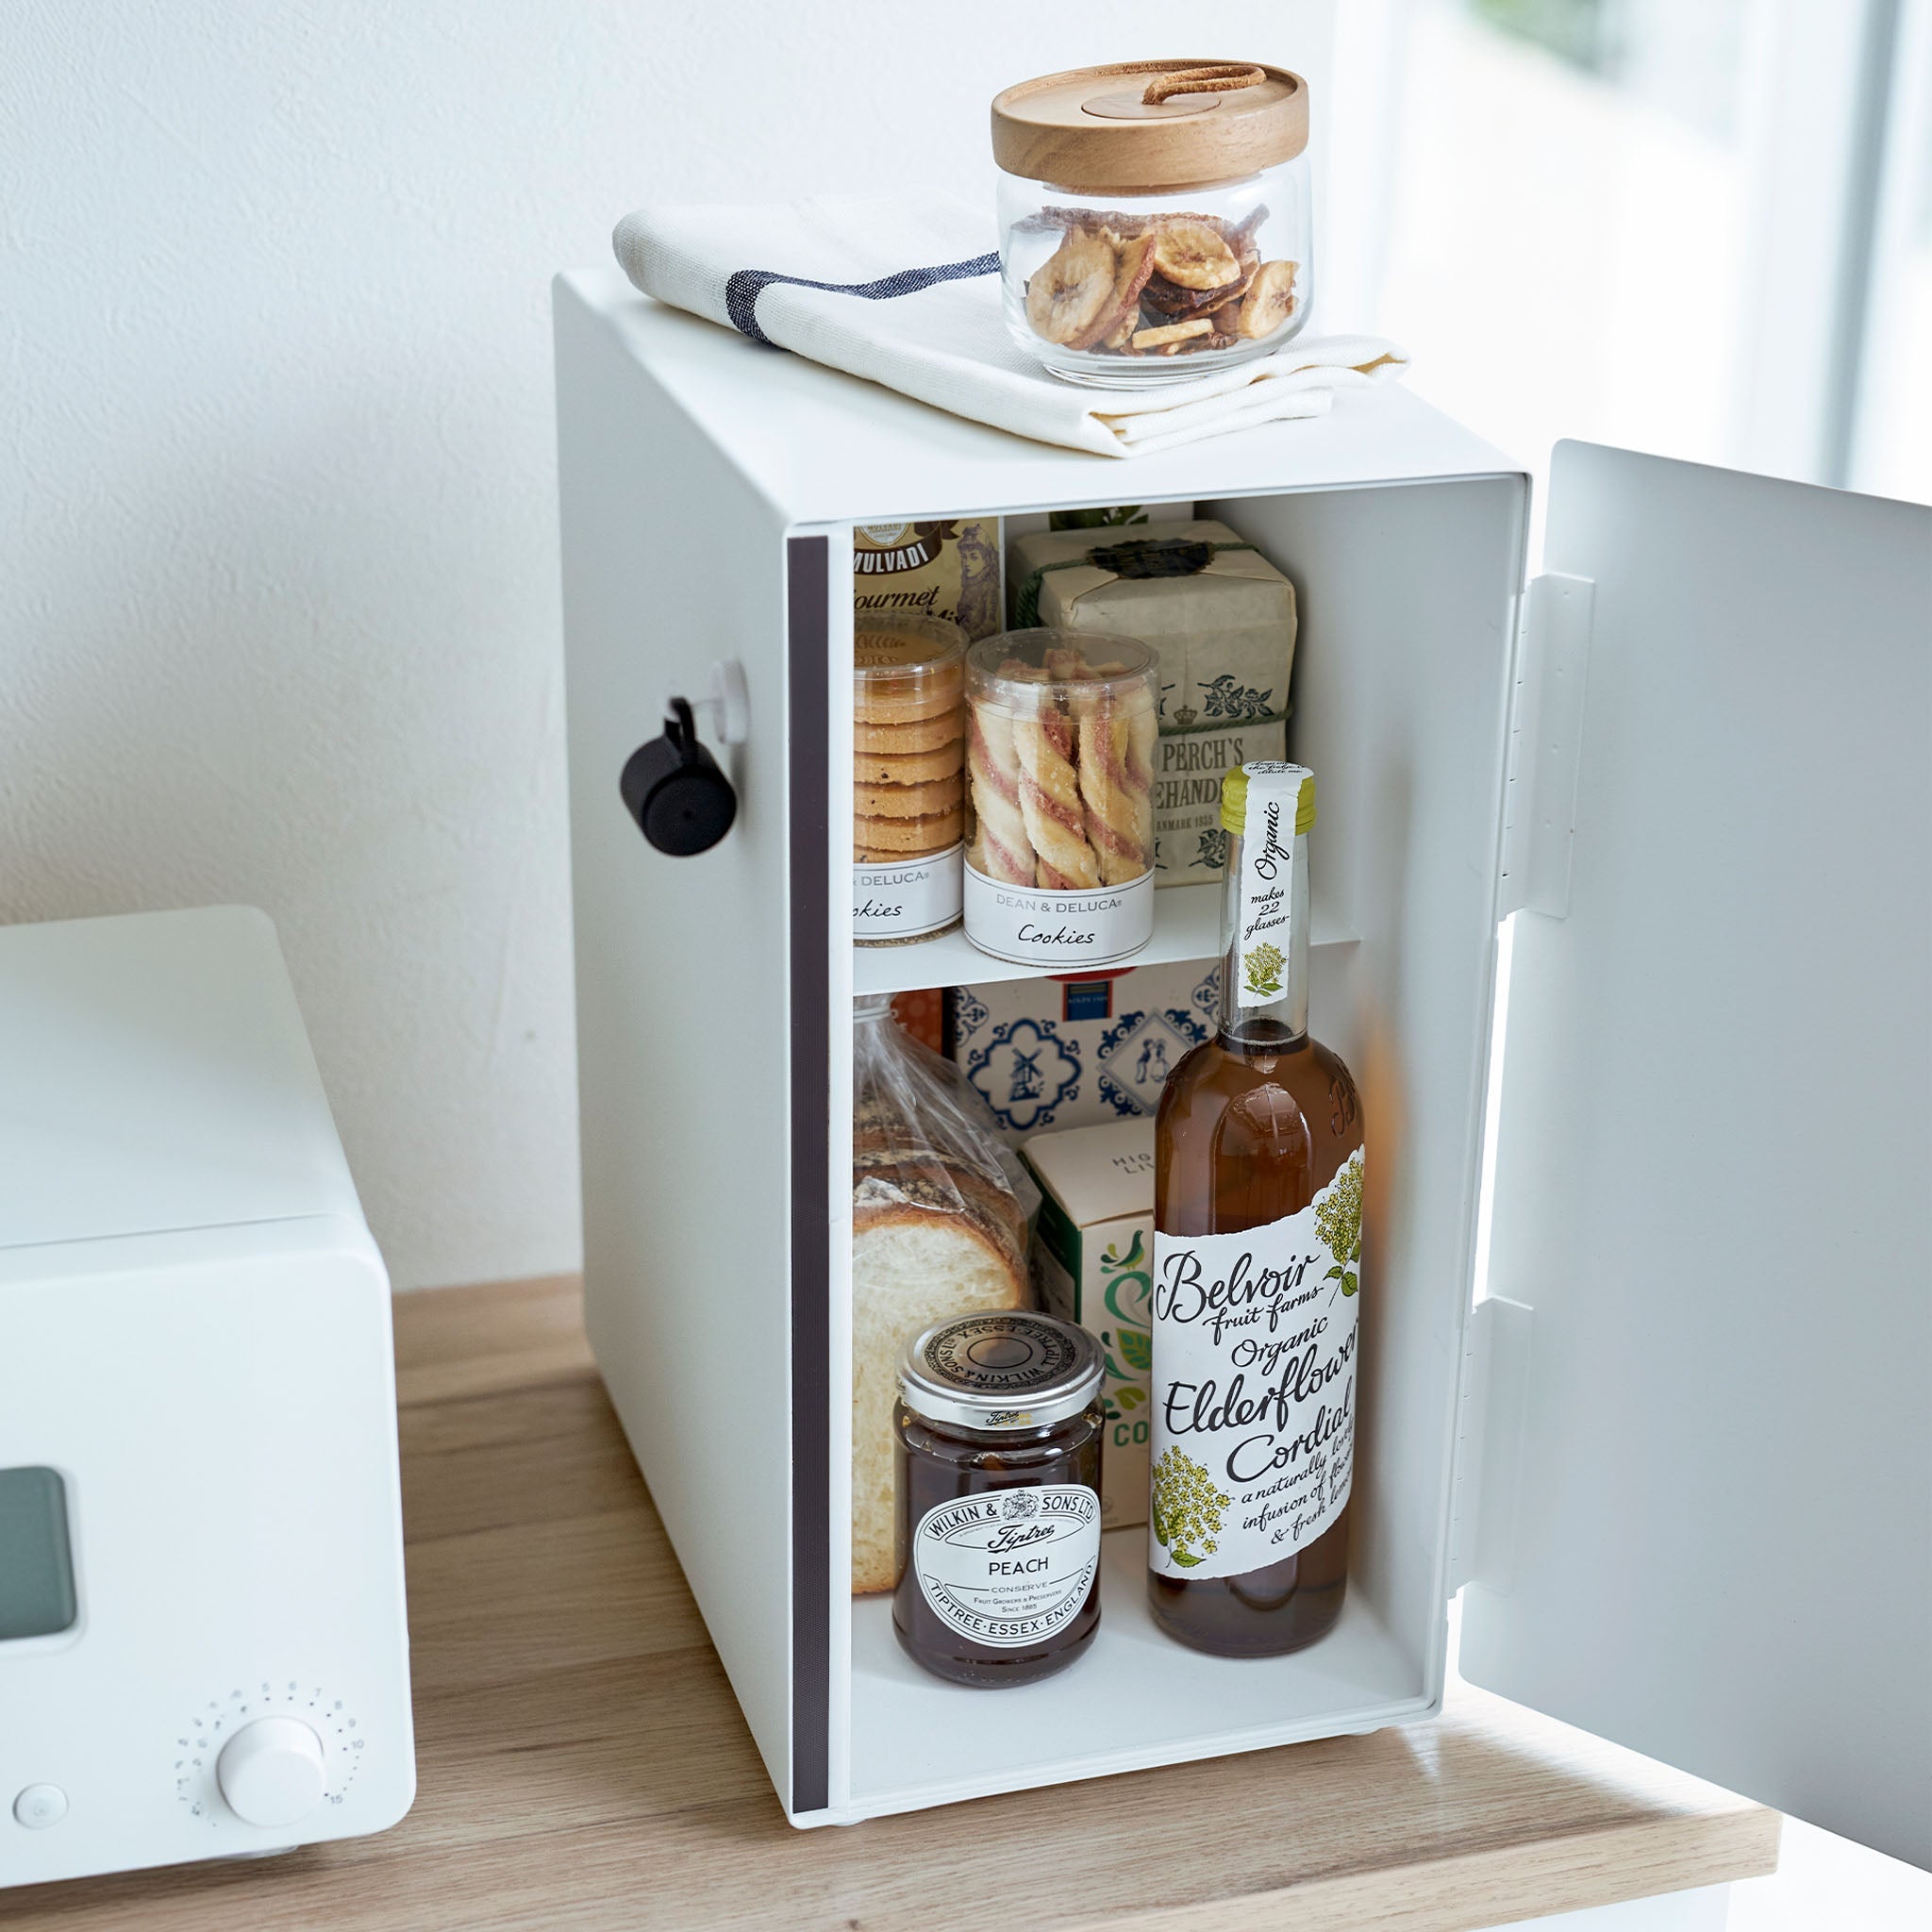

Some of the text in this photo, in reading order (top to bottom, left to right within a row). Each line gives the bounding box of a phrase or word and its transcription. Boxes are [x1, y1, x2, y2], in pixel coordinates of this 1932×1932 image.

[854, 586, 941, 610] ourmet
[1161, 738, 1244, 773] PERCH'S
[1254, 801, 1291, 880] Organic
[996, 893, 1036, 911] DEAN
[1040, 901, 1051, 913] &
[1250, 886, 1285, 904] makes
[1257, 901, 1280, 917] 22
[1017, 924, 1095, 945] Cookies
[1243, 914, 1291, 941] glasses
[1156, 1249, 1321, 1324] Belvoir
[1202, 1286, 1324, 1346] fruit farms
[1231, 1316, 1328, 1376] Organic
[1162, 1316, 1359, 1436] Elderflower
[1225, 1374, 1353, 1483] Cordial
[1254, 1453, 1326, 1500] naturally
[928, 1505, 980, 1538] WILKIN
[986, 1502, 997, 1517] &
[1041, 1495, 1079, 1511] SONS
[1078, 1500, 1095, 1521] LTD
[1242, 1469, 1326, 1532] infusion of
[1270, 1527, 1290, 1544] &
[1290, 1496, 1325, 1542] fresh
[987, 1523, 1056, 1555] Tiptree
[988, 1556, 1049, 1576] PEACH
[991, 1580, 1049, 1594] CONSERVE
[930, 1563, 1092, 1636] TIPTREE ESSEX ENGLAND
